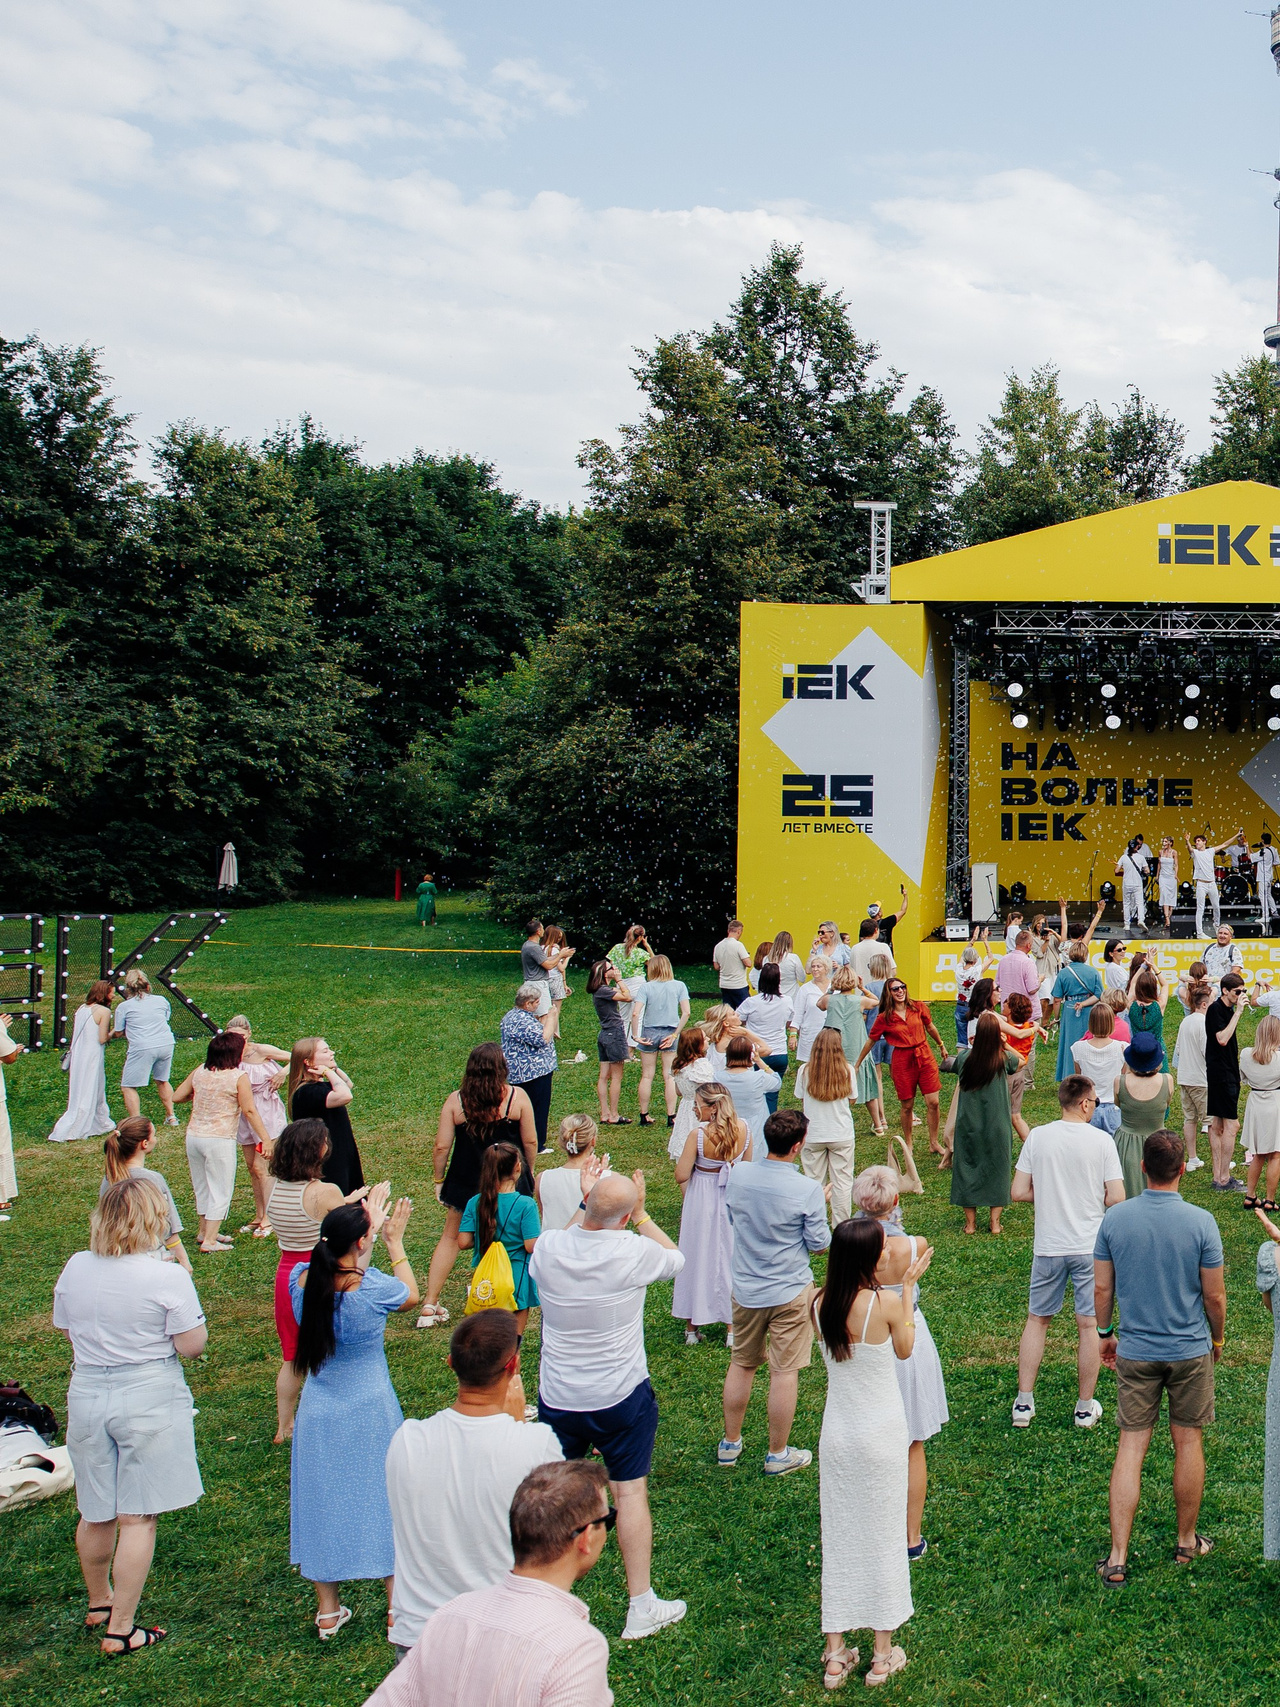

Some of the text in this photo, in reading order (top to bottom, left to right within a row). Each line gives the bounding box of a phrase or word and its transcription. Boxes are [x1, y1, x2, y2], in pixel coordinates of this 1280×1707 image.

[1001, 741, 1081, 771] НА
[781, 773, 874, 818] 25
[1000, 777, 1194, 807] ВОЛНЕ
[781, 822, 874, 834] ЛЕТ ВМЕСТЕ
